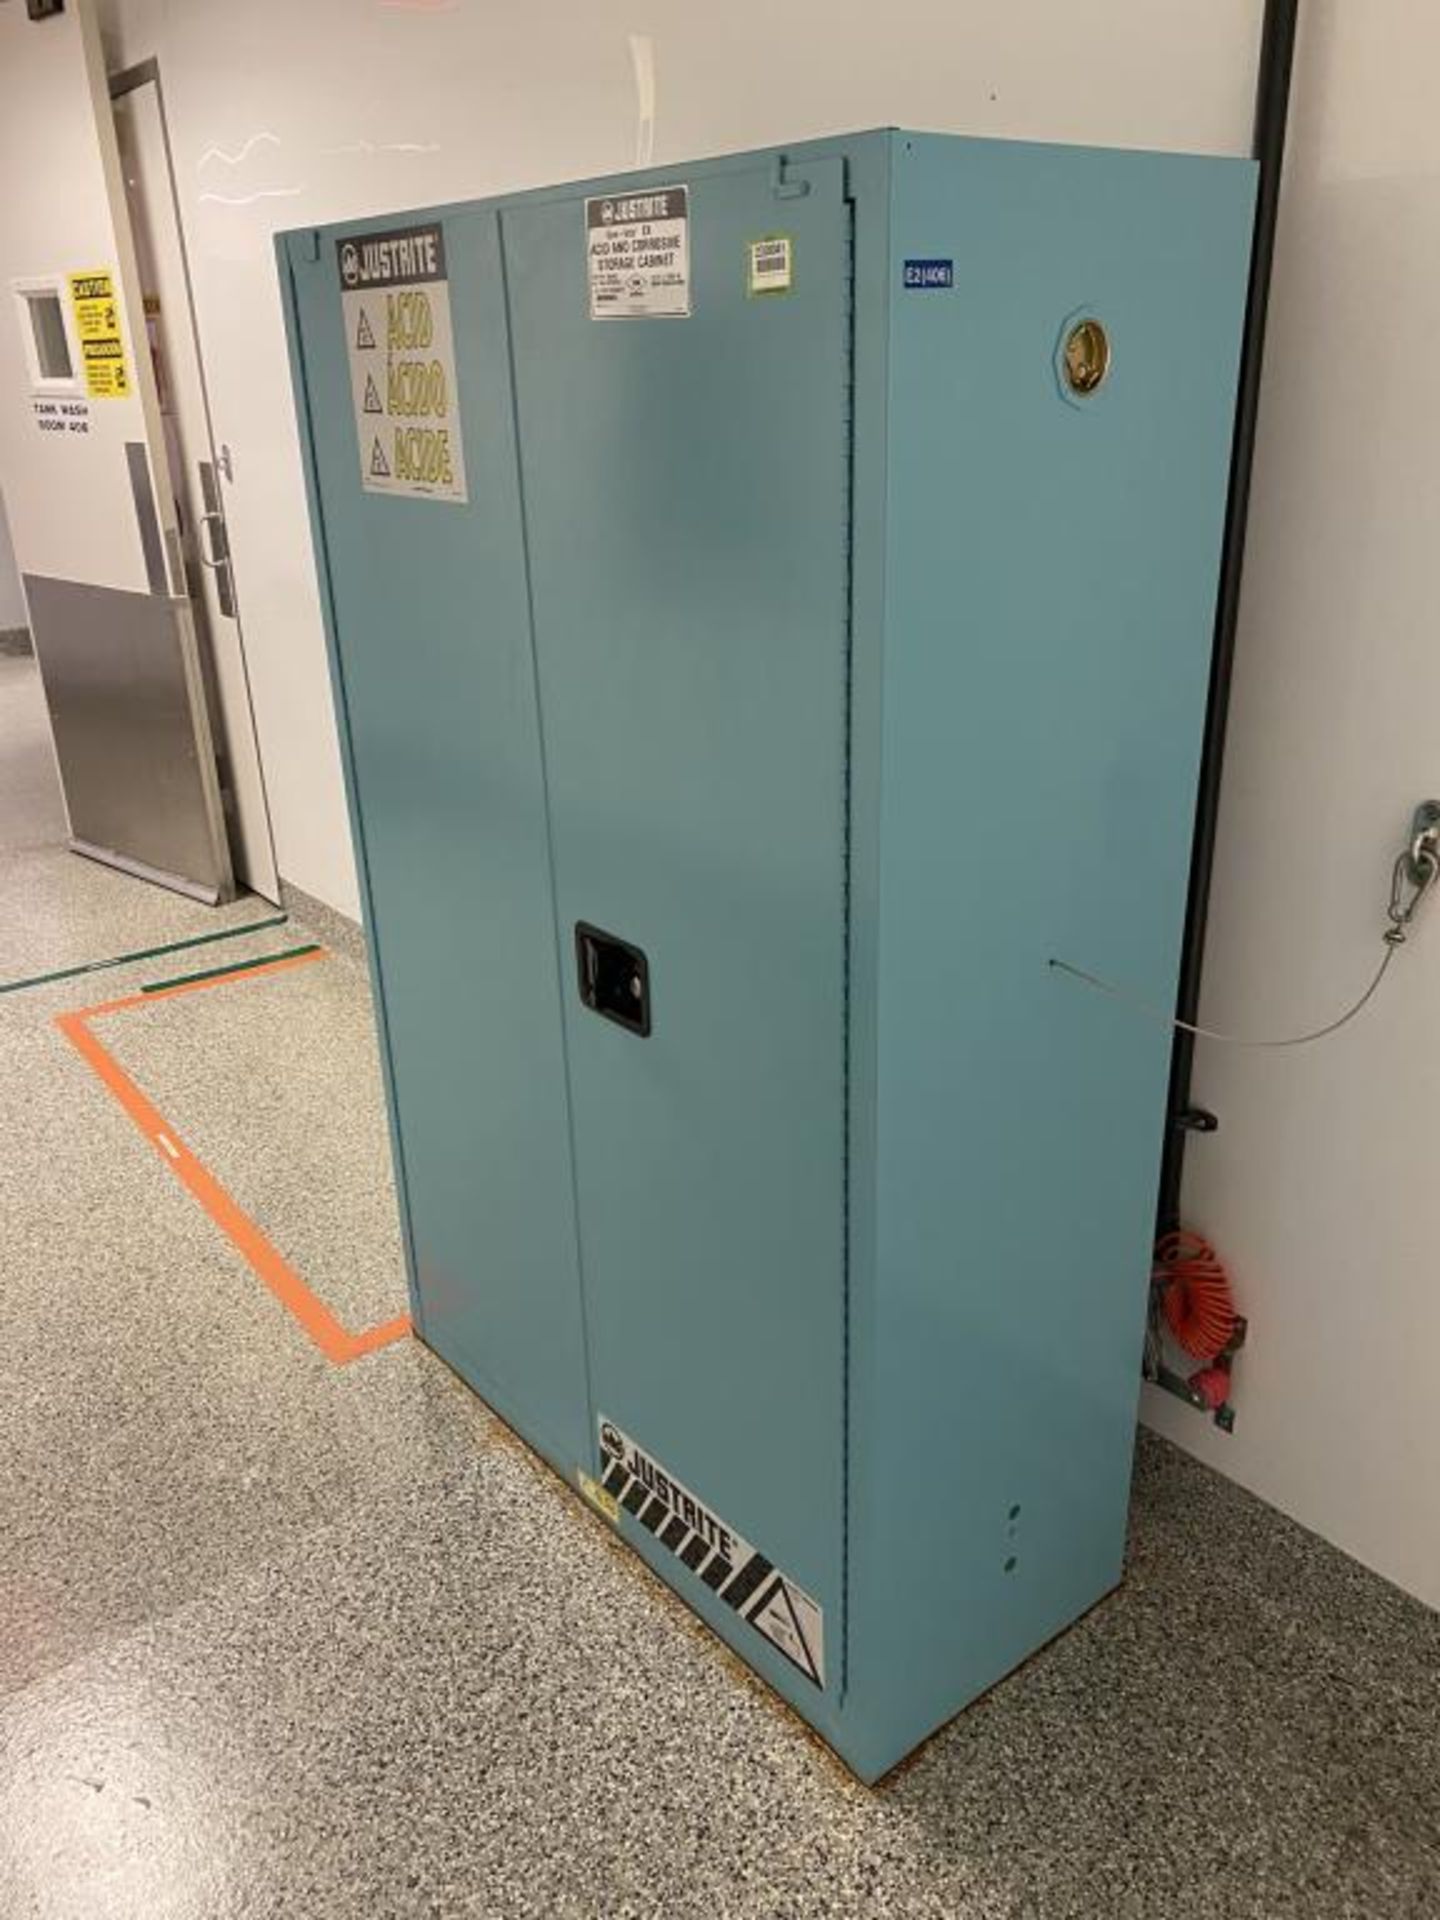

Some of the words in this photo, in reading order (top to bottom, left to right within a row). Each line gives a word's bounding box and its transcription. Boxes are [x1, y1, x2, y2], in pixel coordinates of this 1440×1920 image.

[614, 194, 668, 221] JUSTRITE
[360, 232, 438, 281] JUSTRITE
[638, 253, 674, 268] CABINET
[387, 292, 433, 349] ACID
[394, 426, 454, 485] ACIDE
[627, 1449, 733, 1562] JUSTRITE
